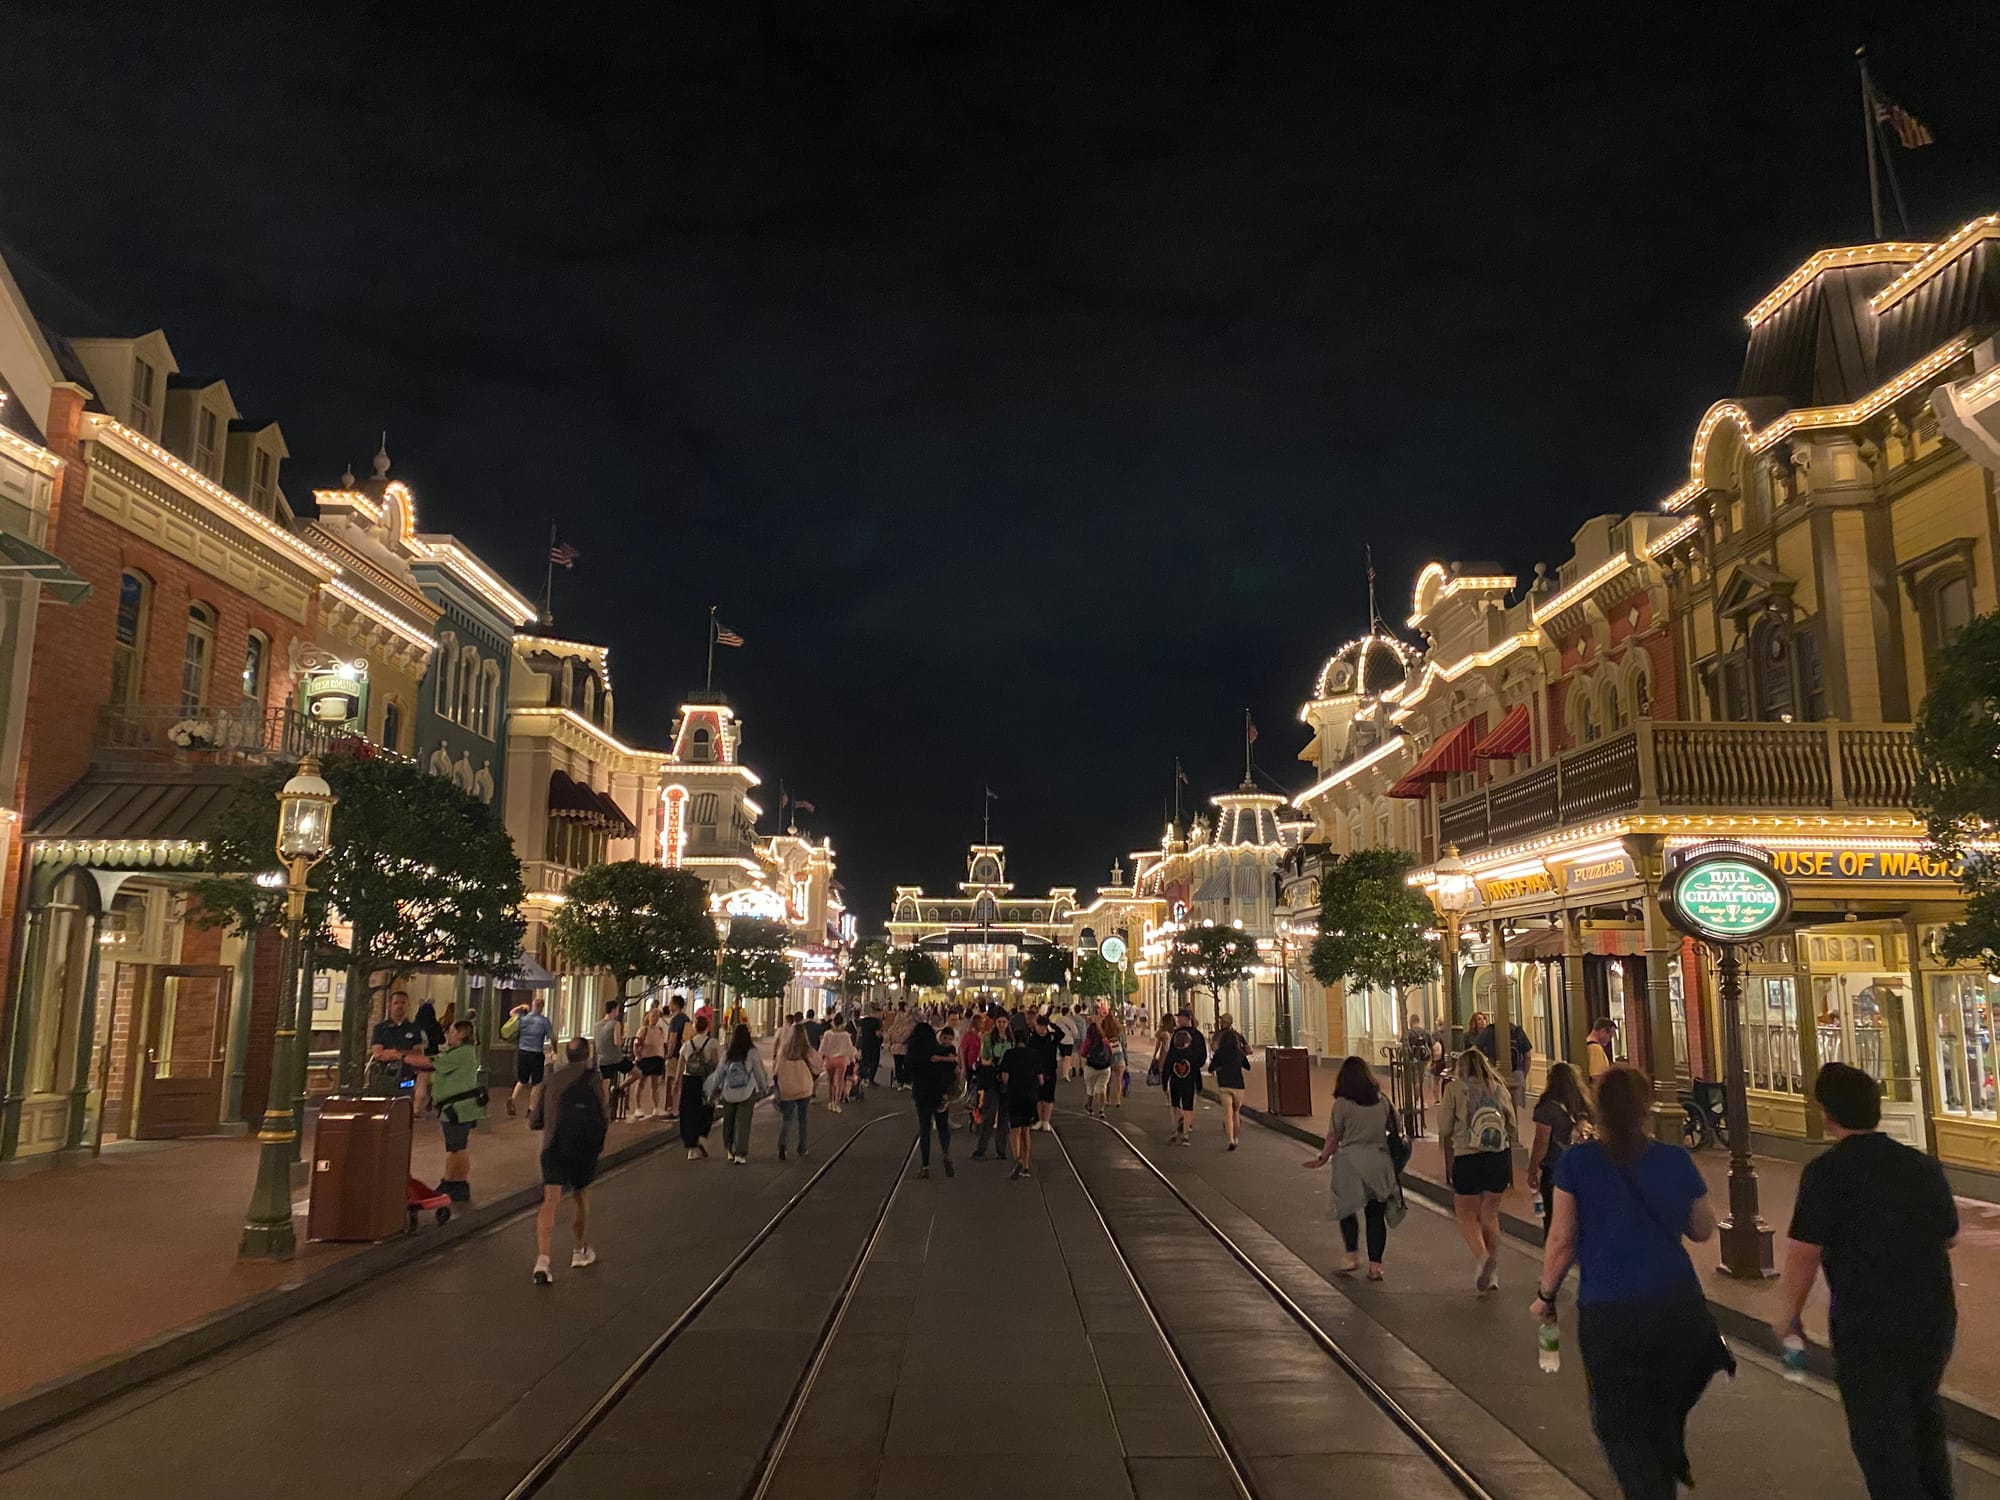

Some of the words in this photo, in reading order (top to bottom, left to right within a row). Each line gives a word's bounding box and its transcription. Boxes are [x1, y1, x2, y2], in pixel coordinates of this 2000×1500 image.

[668, 801, 679, 845] CRYSTAL
[1573, 859, 1625, 882] PUZZLES
[1774, 851, 1833, 876] USE
[1839, 852, 1875, 876] OF
[1709, 871, 1750, 883] HALL
[1727, 882, 1738, 891] of
[1685, 890, 1775, 904] CHAMPIONS
